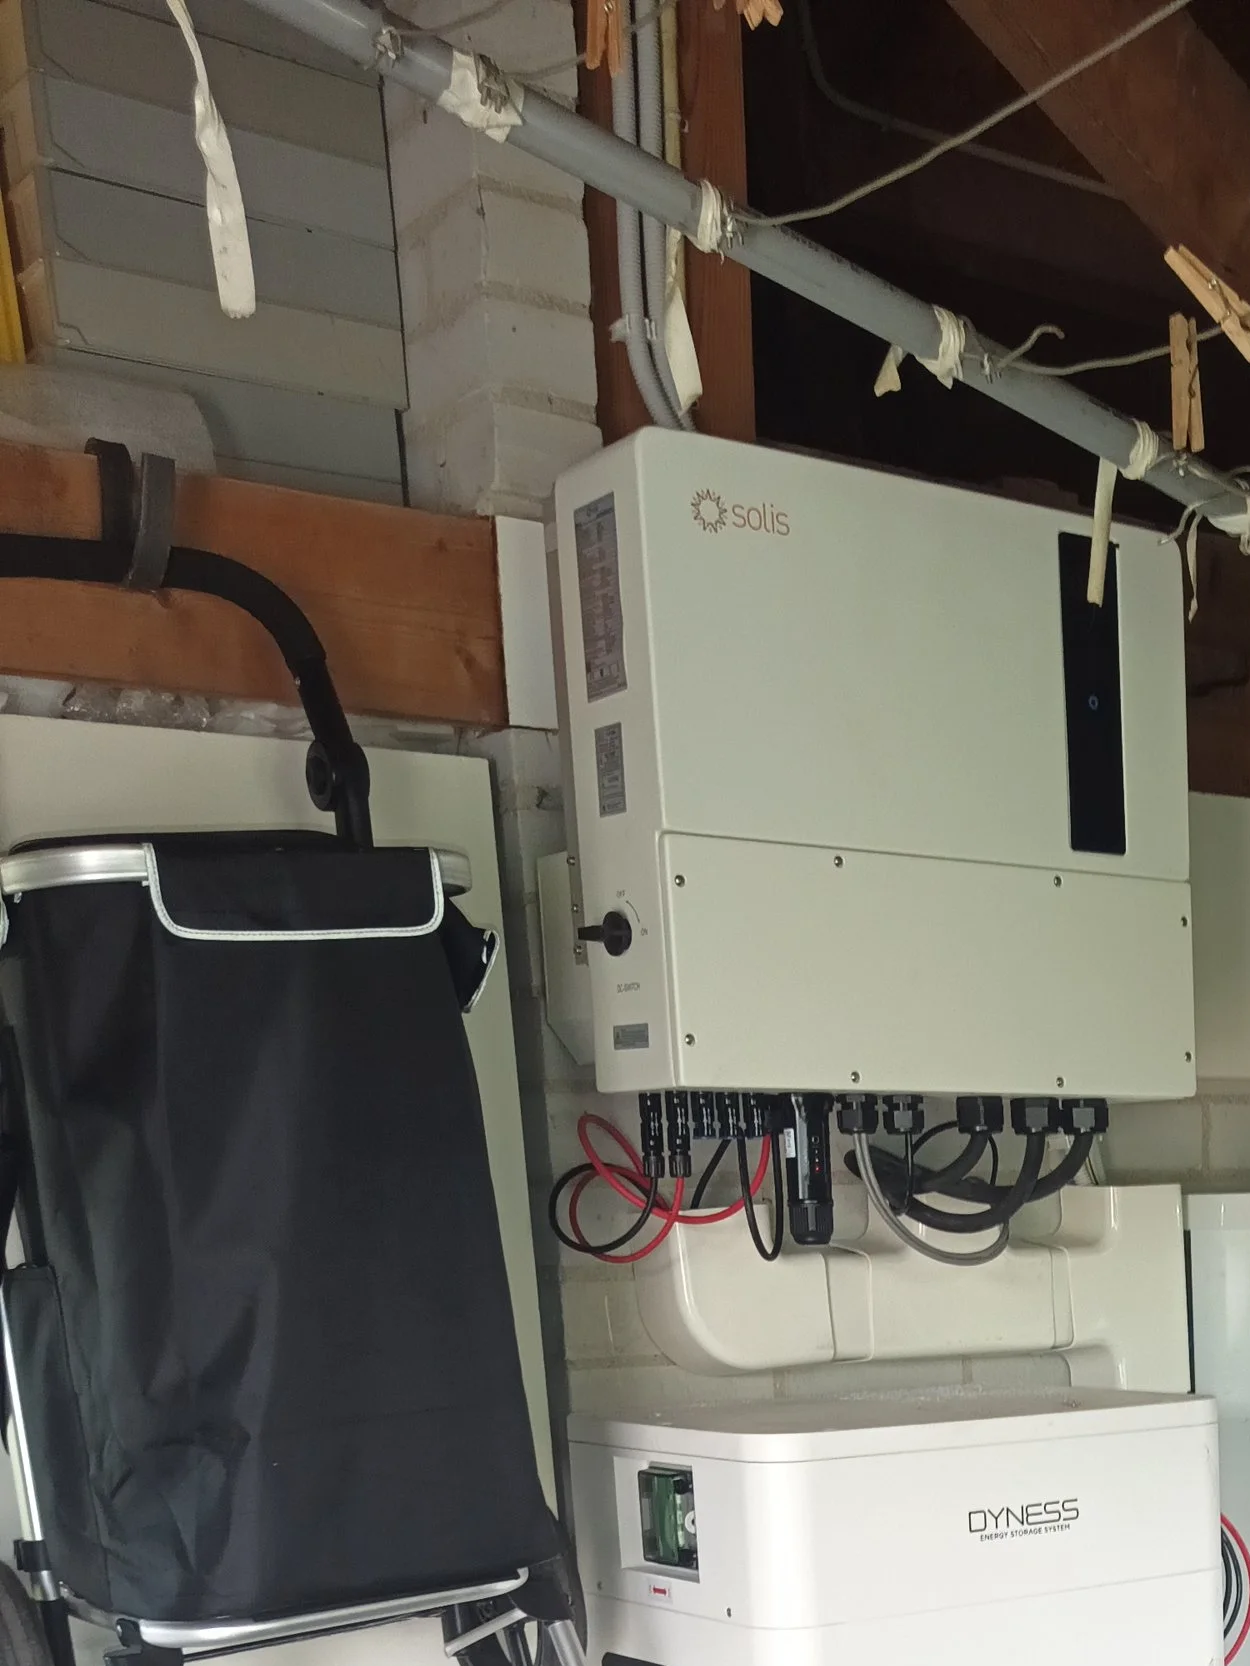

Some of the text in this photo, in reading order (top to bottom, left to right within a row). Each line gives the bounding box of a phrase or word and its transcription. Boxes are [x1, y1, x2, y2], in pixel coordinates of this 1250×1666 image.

[731, 502, 791, 536] solis
[968, 1498, 1080, 1533] DYNESS
[980, 1523, 1071, 1542] ENERGY STORAGE SYSTEM
